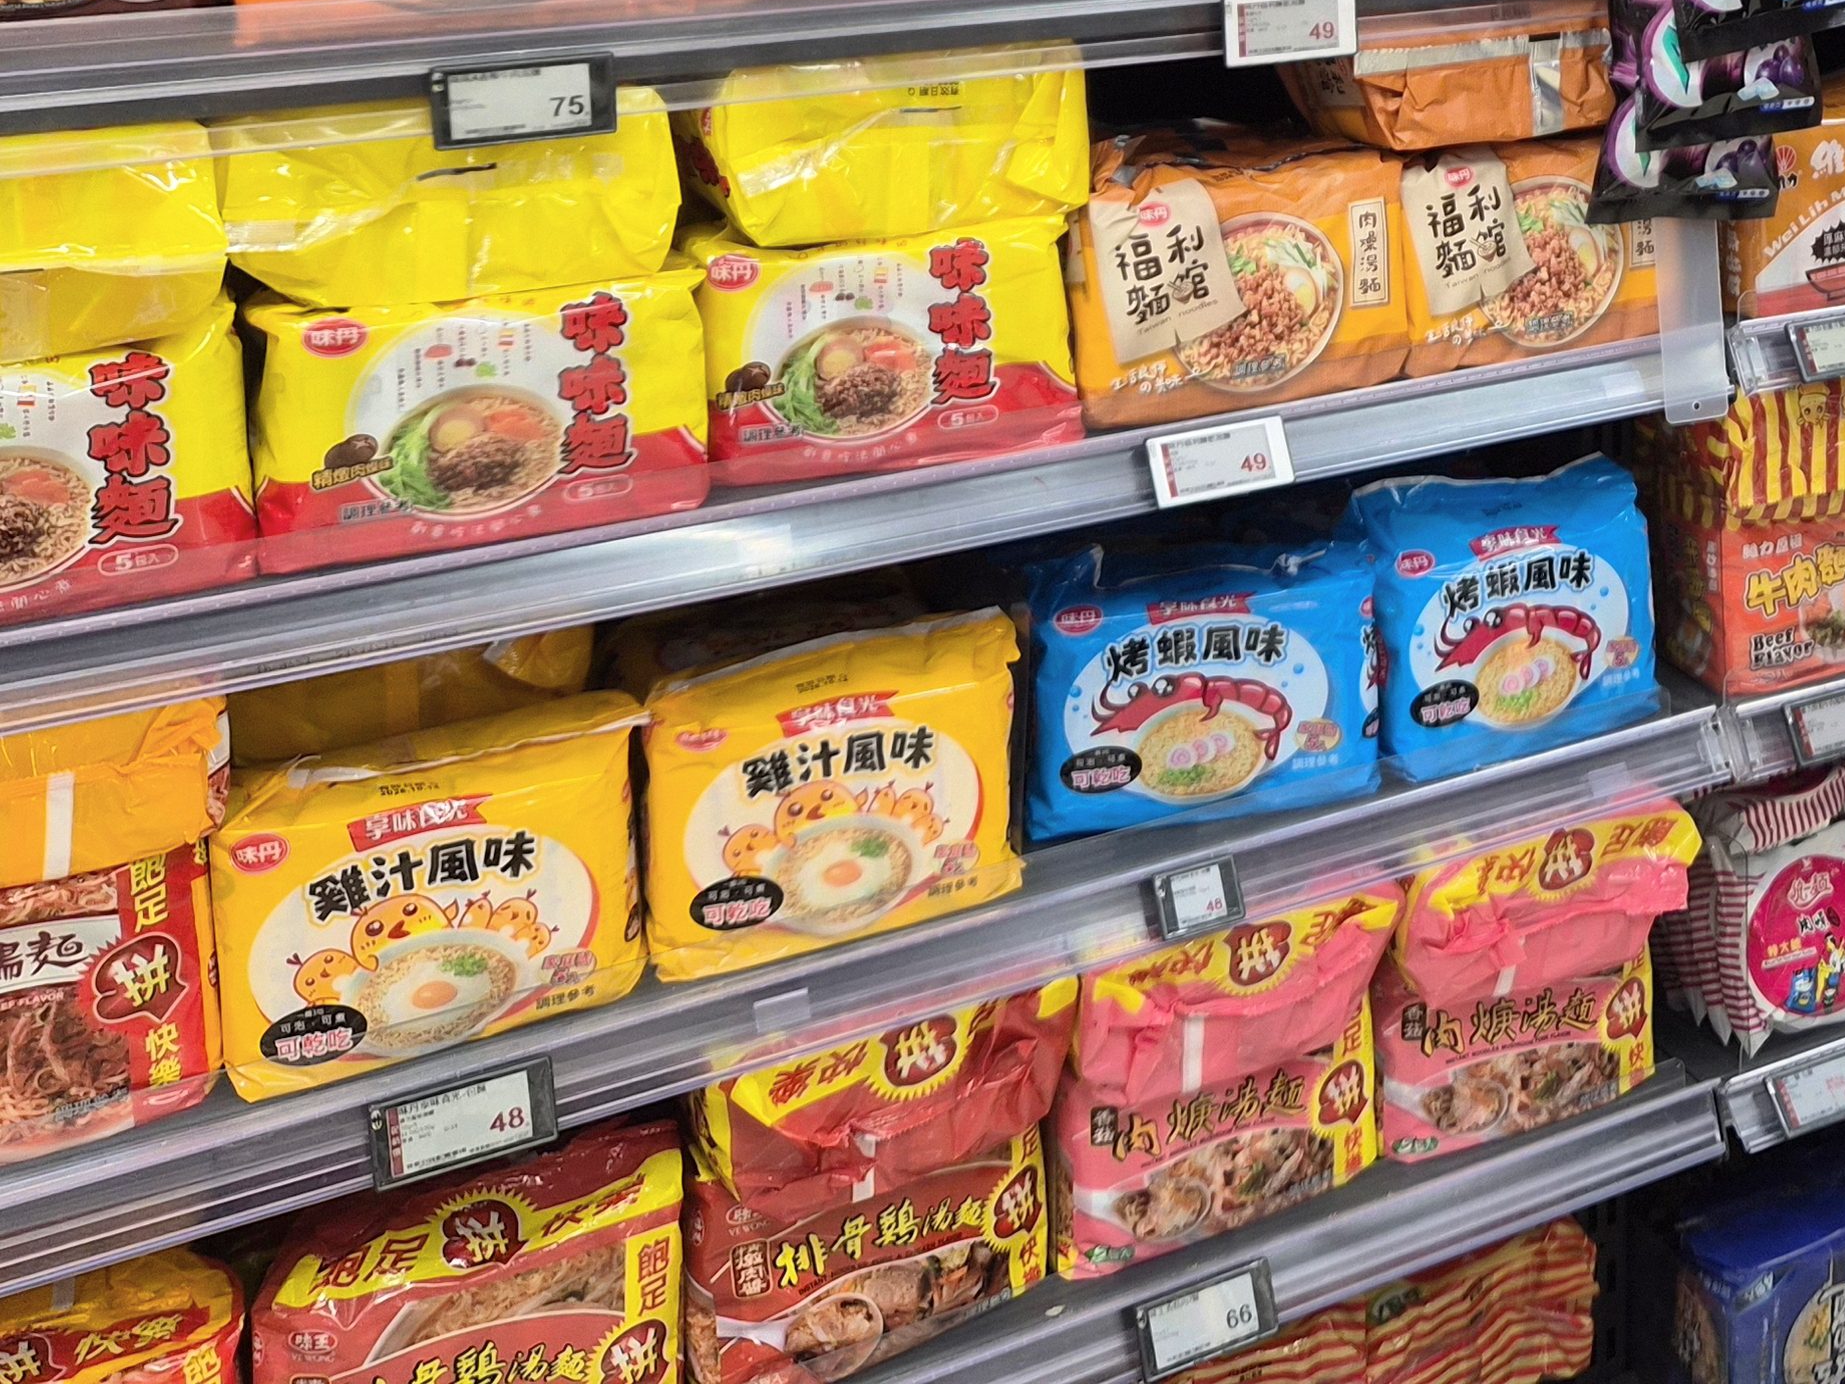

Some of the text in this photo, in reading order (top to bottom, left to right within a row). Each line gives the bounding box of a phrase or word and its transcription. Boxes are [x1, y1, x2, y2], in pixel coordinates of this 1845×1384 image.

[1309, 21, 1335, 40] 49
[550, 95, 585, 116] 75
[1426, 184, 1501, 238] 福利
[1764, 222, 1798, 258] Wei
[1799, 197, 1828, 227] Lih
[1115, 224, 1204, 282] 福利
[1358, 211, 1381, 294] 肉燥湯麵
[712, 262, 752, 282] 味丹
[311, 329, 358, 347] 味丹
[1240, 452, 1267, 472] 49
[115, 554, 160, 571] 5包入
[1442, 551, 1593, 615] 烤蝦風味
[1104, 622, 1286, 682] 烤蝦風味
[1750, 627, 1794, 654] Beef
[1750, 641, 1814, 670] Flavor
[742, 726, 934, 797] 雞汁風味
[1072, 767, 1131, 789] 可乾吃
[236, 842, 283, 863] 味丹
[308, 830, 537, 921] 雞汁風味
[130, 854, 168, 933] 飽足
[1207, 898, 1223, 912] 48
[702, 898, 772, 926] 可乾吃
[113, 944, 170, 1007] 拼
[536, 986, 596, 1010] 調理參考
[145, 1022, 182, 1089] 快樂
[275, 1027, 354, 1060] 可乾吃
[490, 1108, 525, 1132] 48
[638, 1239, 668, 1316] 飽足
[1226, 1304, 1253, 1329] 66
[294, 1332, 329, 1348] 味王
[610, 1328, 659, 1382] 拼
